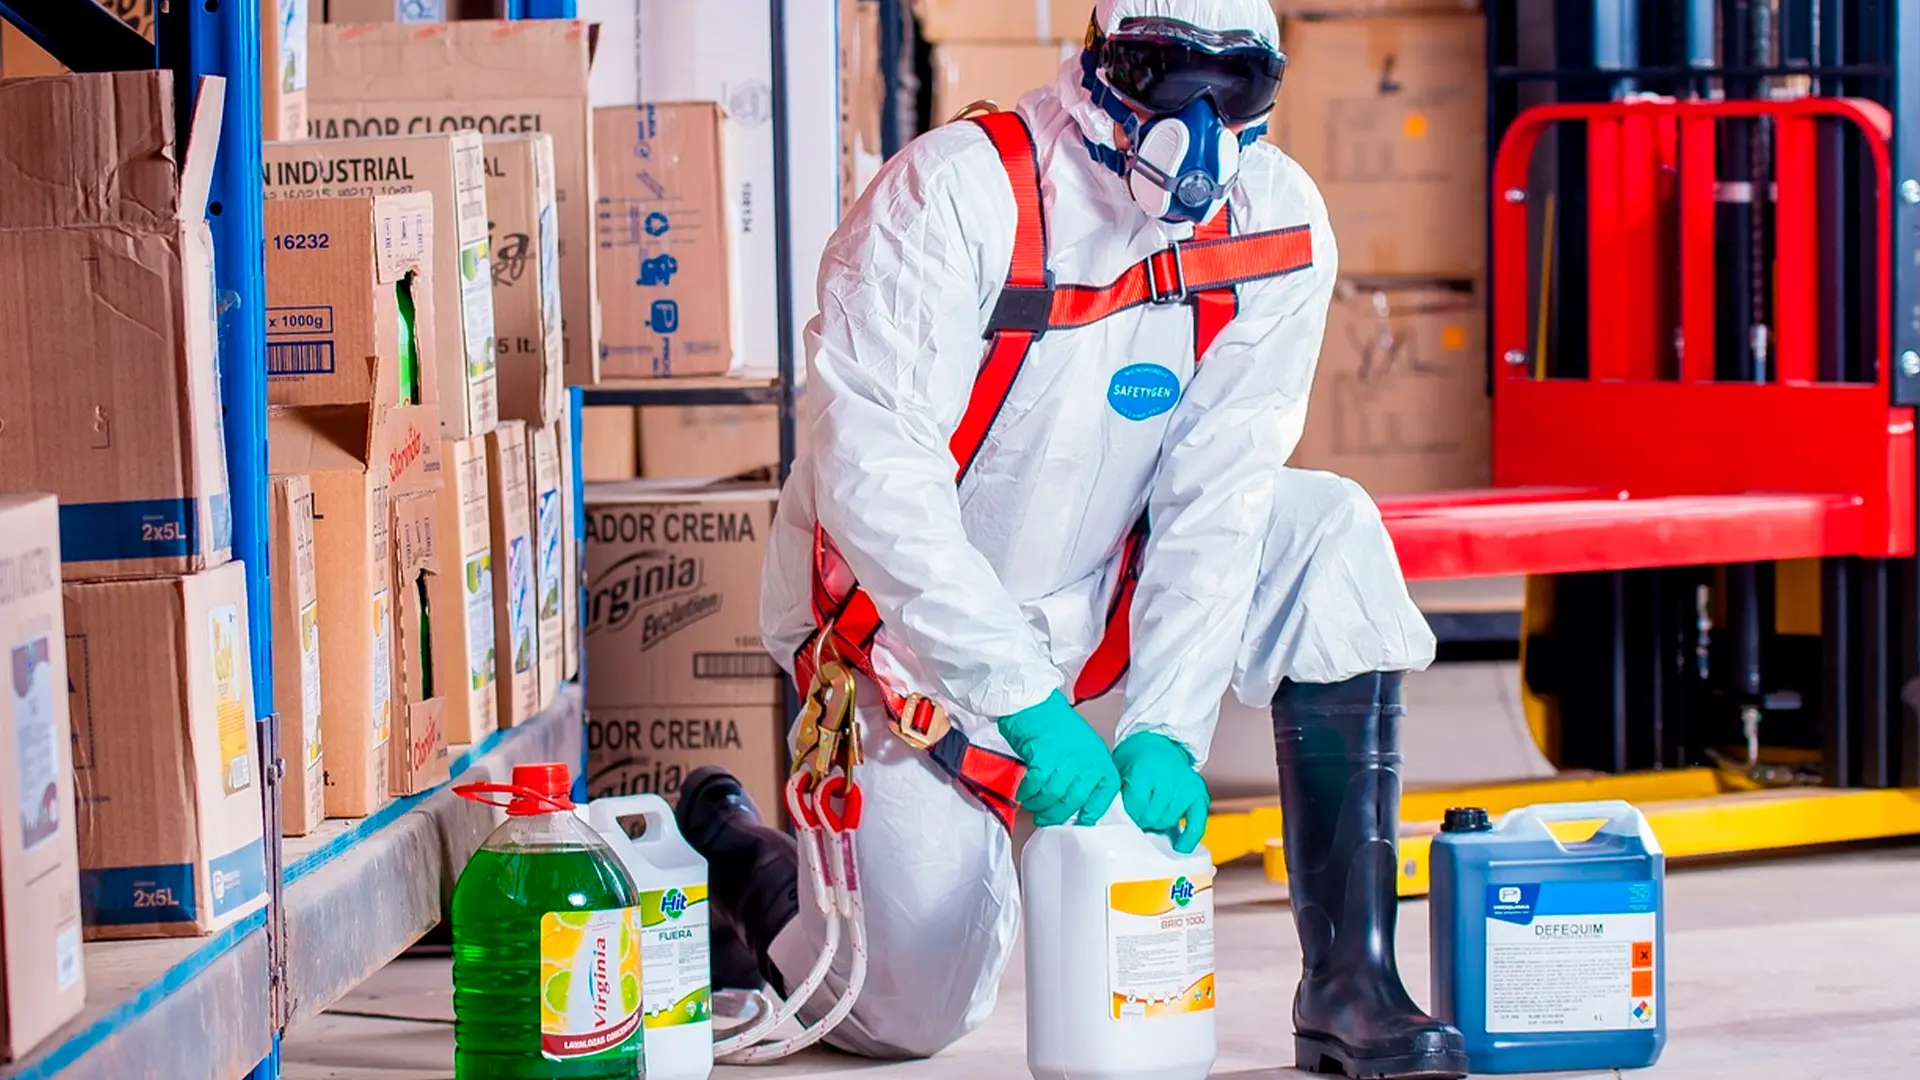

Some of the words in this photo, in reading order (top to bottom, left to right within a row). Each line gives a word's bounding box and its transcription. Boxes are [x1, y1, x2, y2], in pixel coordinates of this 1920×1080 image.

[278, 156, 414, 186] INDUSTRIAL
[274, 234, 330, 250] 16232
[269, 319, 277, 328] x
[282, 315, 323, 328] 1000g
[498, 338, 509, 354] 5
[1113, 384, 1171, 398] SAFETYGEN
[142, 522, 187, 540] 2x5L
[664, 512, 756, 542] CREMA
[651, 719, 741, 749] CREMA
[134, 887, 179, 907] 2x5L
[1171, 881, 1194, 900] Hit
[661, 892, 687, 912] Hit
[658, 930, 692, 941] FUERA
[1535, 924, 1603, 936] DEFEQUIM
[594, 937, 610, 1027] Virginia
